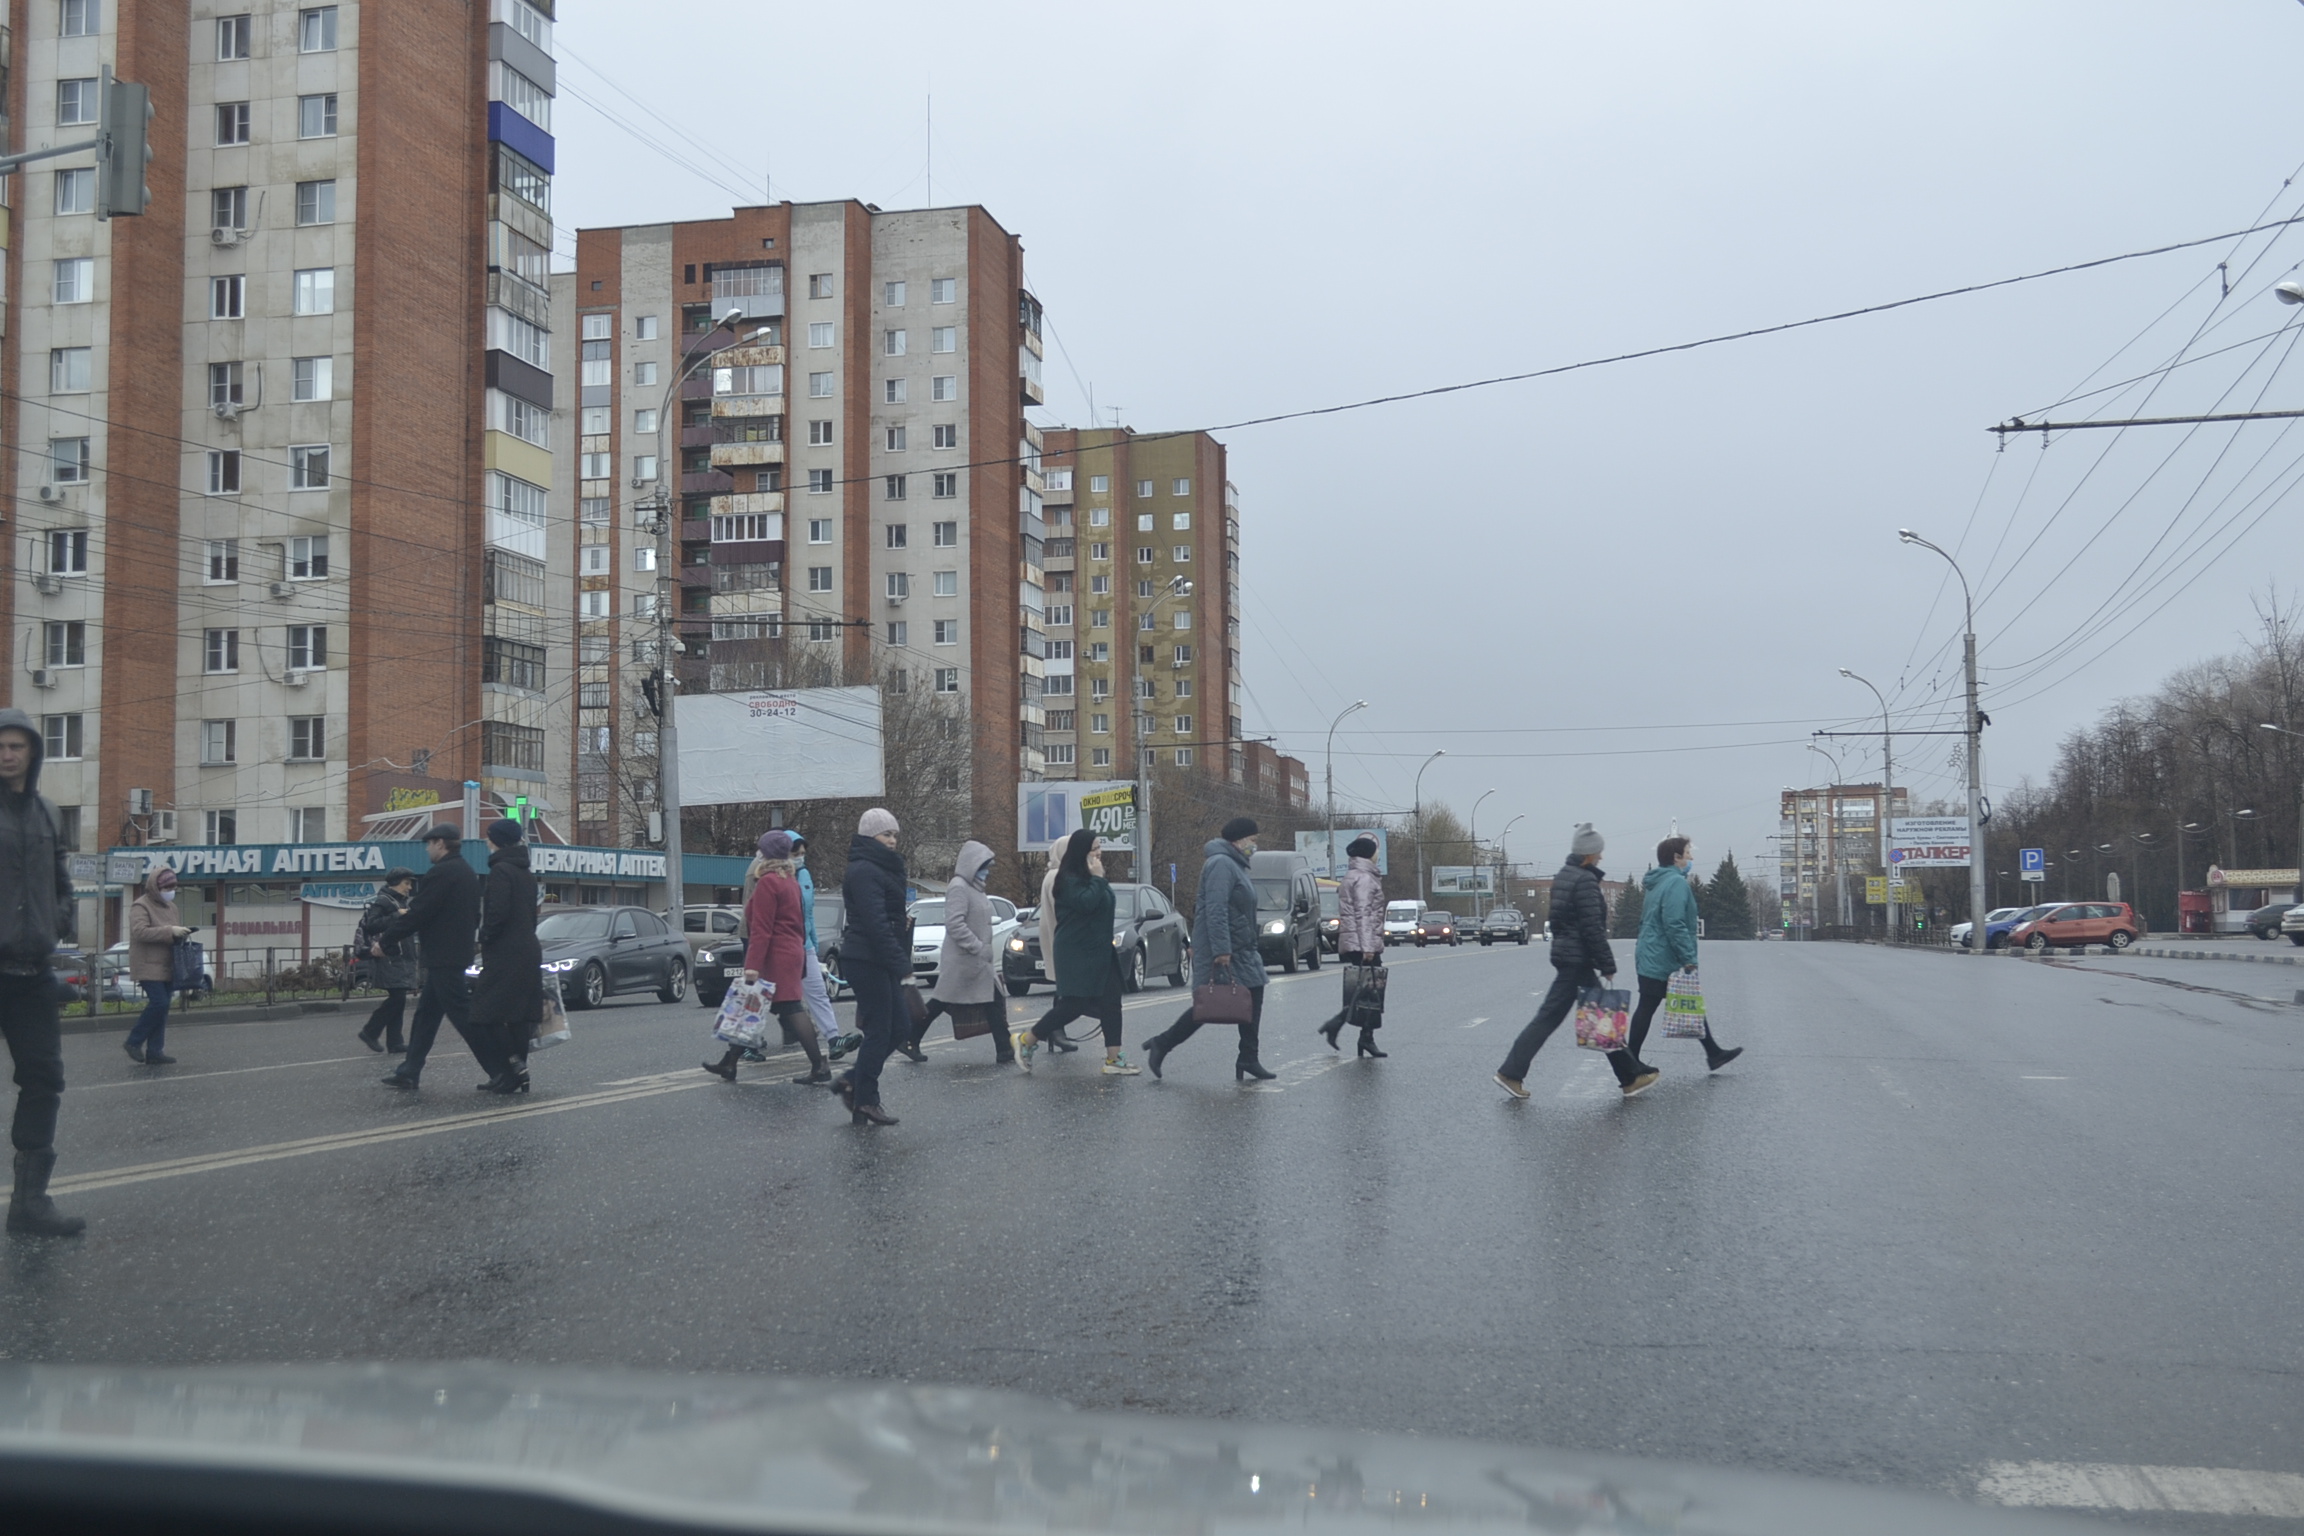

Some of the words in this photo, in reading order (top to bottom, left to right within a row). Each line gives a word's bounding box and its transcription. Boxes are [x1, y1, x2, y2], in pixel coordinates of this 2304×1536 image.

[749, 700, 797, 708] СВОБОДНО
[750, 707, 796, 718] 30-24-12
[1083, 796, 1101, 807] ОКНО
[1089, 806, 1122, 833] 490
[1123, 821, 1136, 831] МЕС
[272, 846, 386, 873] АПТЕКА
[530, 847, 617, 875] ДЕЖУРНАЯ
[618, 854, 667, 877] АПТЕК
[2026, 851, 2039, 869] P
[301, 883, 375, 898] АПТЕКА
[224, 921, 302, 936] СОЦИАЛЬНАЯ
[1680, 999, 1697, 1011] FIX
